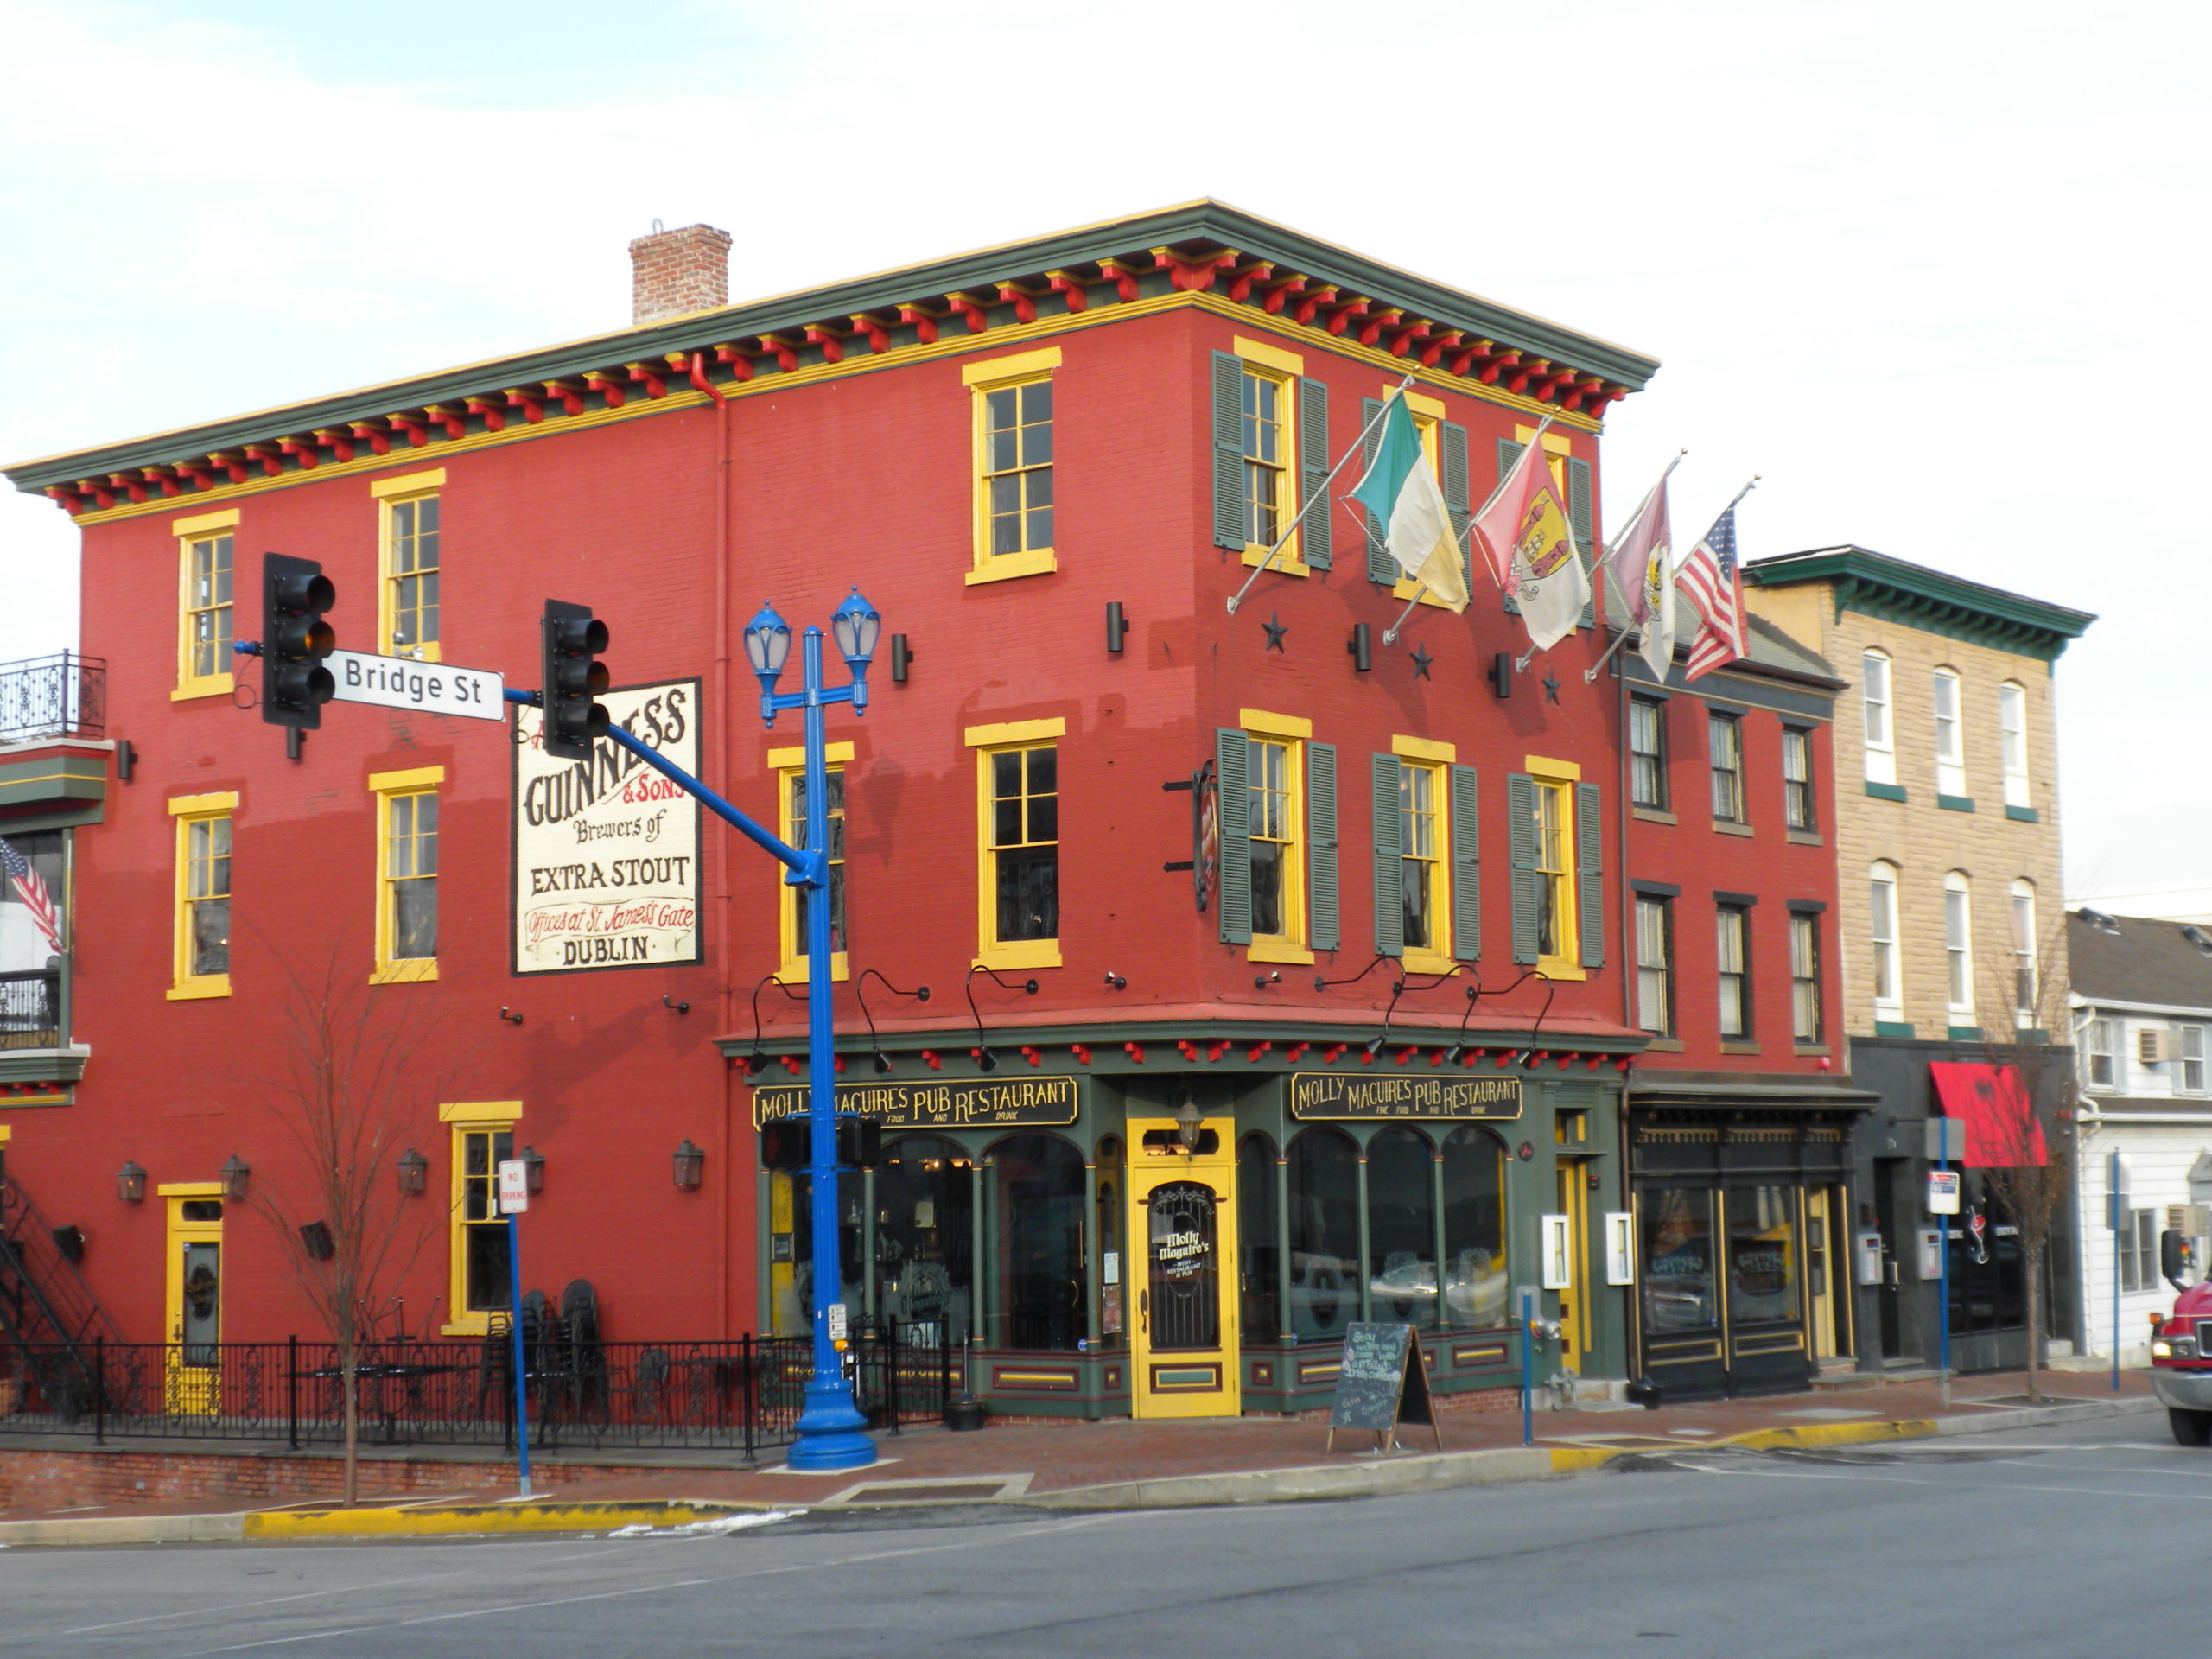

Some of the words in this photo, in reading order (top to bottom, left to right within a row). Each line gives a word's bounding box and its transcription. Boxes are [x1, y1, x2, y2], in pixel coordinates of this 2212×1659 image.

[346, 659, 442, 702] Bridge
[454, 675, 481, 703] St
[524, 688, 686, 826] GUINNESS
[623, 784, 635, 804] &
[574, 817, 642, 844] Brewers
[646, 809, 667, 842] of
[531, 862, 607, 897] EXTRA
[611, 856, 690, 886] STOUT
[529, 912, 565, 942] Offices
[568, 910, 586, 931] at
[658, 905, 694, 928] Gate
[563, 936, 648, 965] DUBLIN
[761, 1090, 811, 1124] MOLL
[913, 1086, 950, 1121] PUB
[955, 1082, 1068, 1122] RESTAURANT
[1299, 1078, 1344, 1111] MOLLY
[1415, 1080, 1441, 1111] PUB
[1444, 1081, 1518, 1116] RESTAURANT
[887, 1115, 905, 1123] FOOD
[933, 1114, 948, 1122] AND
[995, 1111, 1019, 1121] DRINK
[508, 1172, 518, 1183] NO
[502, 1191, 525, 1200] PARKING
[1160, 1242, 1210, 1261] Maguire's
[1167, 1231, 1199, 1248] Molly
[1166, 1262, 1201, 1274] RESTAURANT
